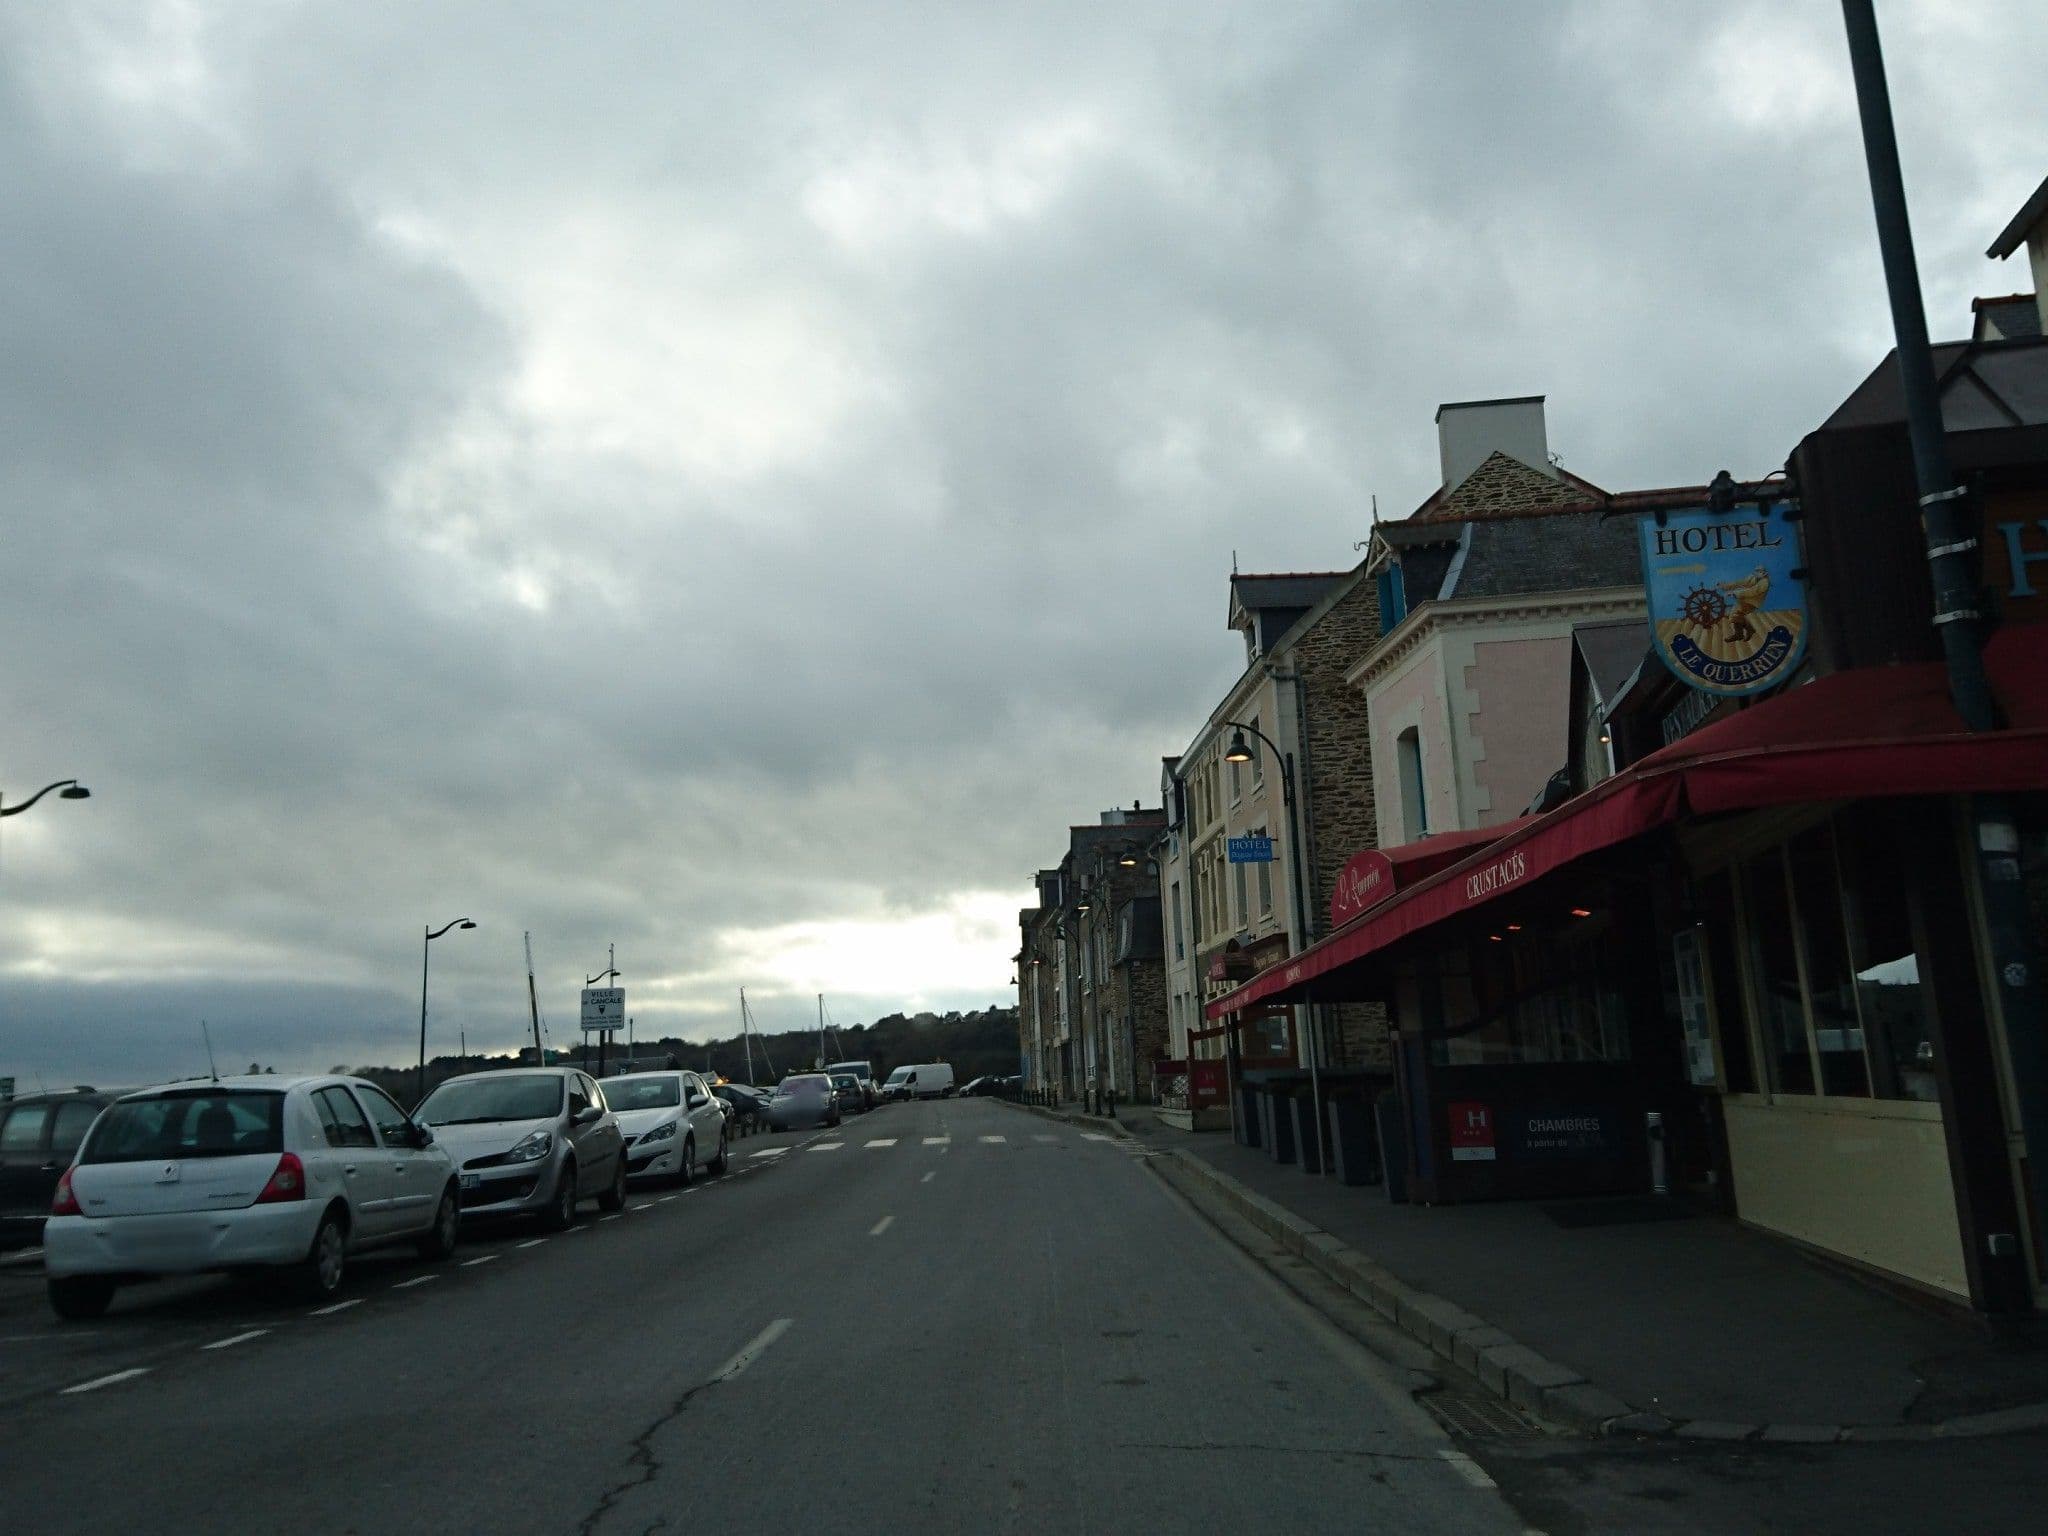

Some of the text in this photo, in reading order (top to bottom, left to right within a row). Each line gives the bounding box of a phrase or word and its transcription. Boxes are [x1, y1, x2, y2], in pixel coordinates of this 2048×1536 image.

[1656, 522, 1783, 556] HOTEL
[1679, 638, 1787, 681] LE QUERRIEN
[1232, 840, 1268, 849] HOTEL
[1466, 850, 1525, 900] CRUSTACÉS
[1528, 1118, 1600, 1132] CHAMBRES
